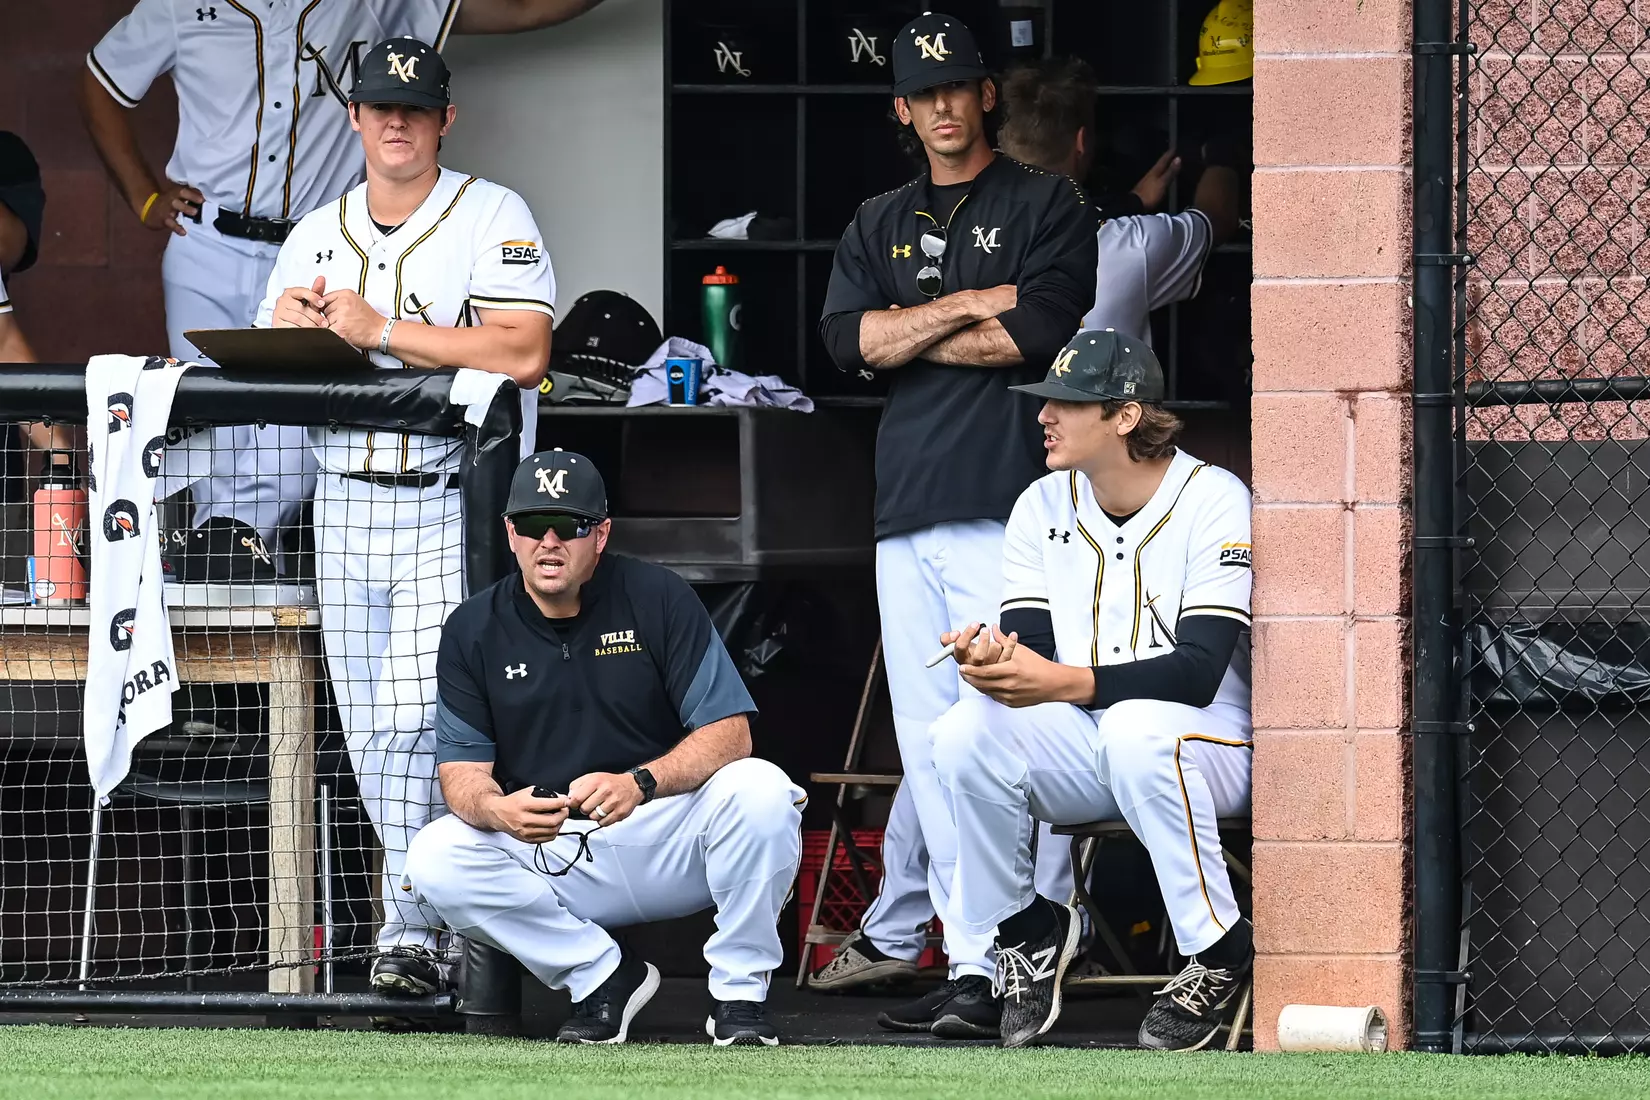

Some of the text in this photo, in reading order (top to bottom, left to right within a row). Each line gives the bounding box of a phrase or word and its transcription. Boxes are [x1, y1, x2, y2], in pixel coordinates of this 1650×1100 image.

[502, 247, 540, 260] PSAC
[600, 629, 635, 646] VILLE
[594, 643, 643, 657] BASEBALL
